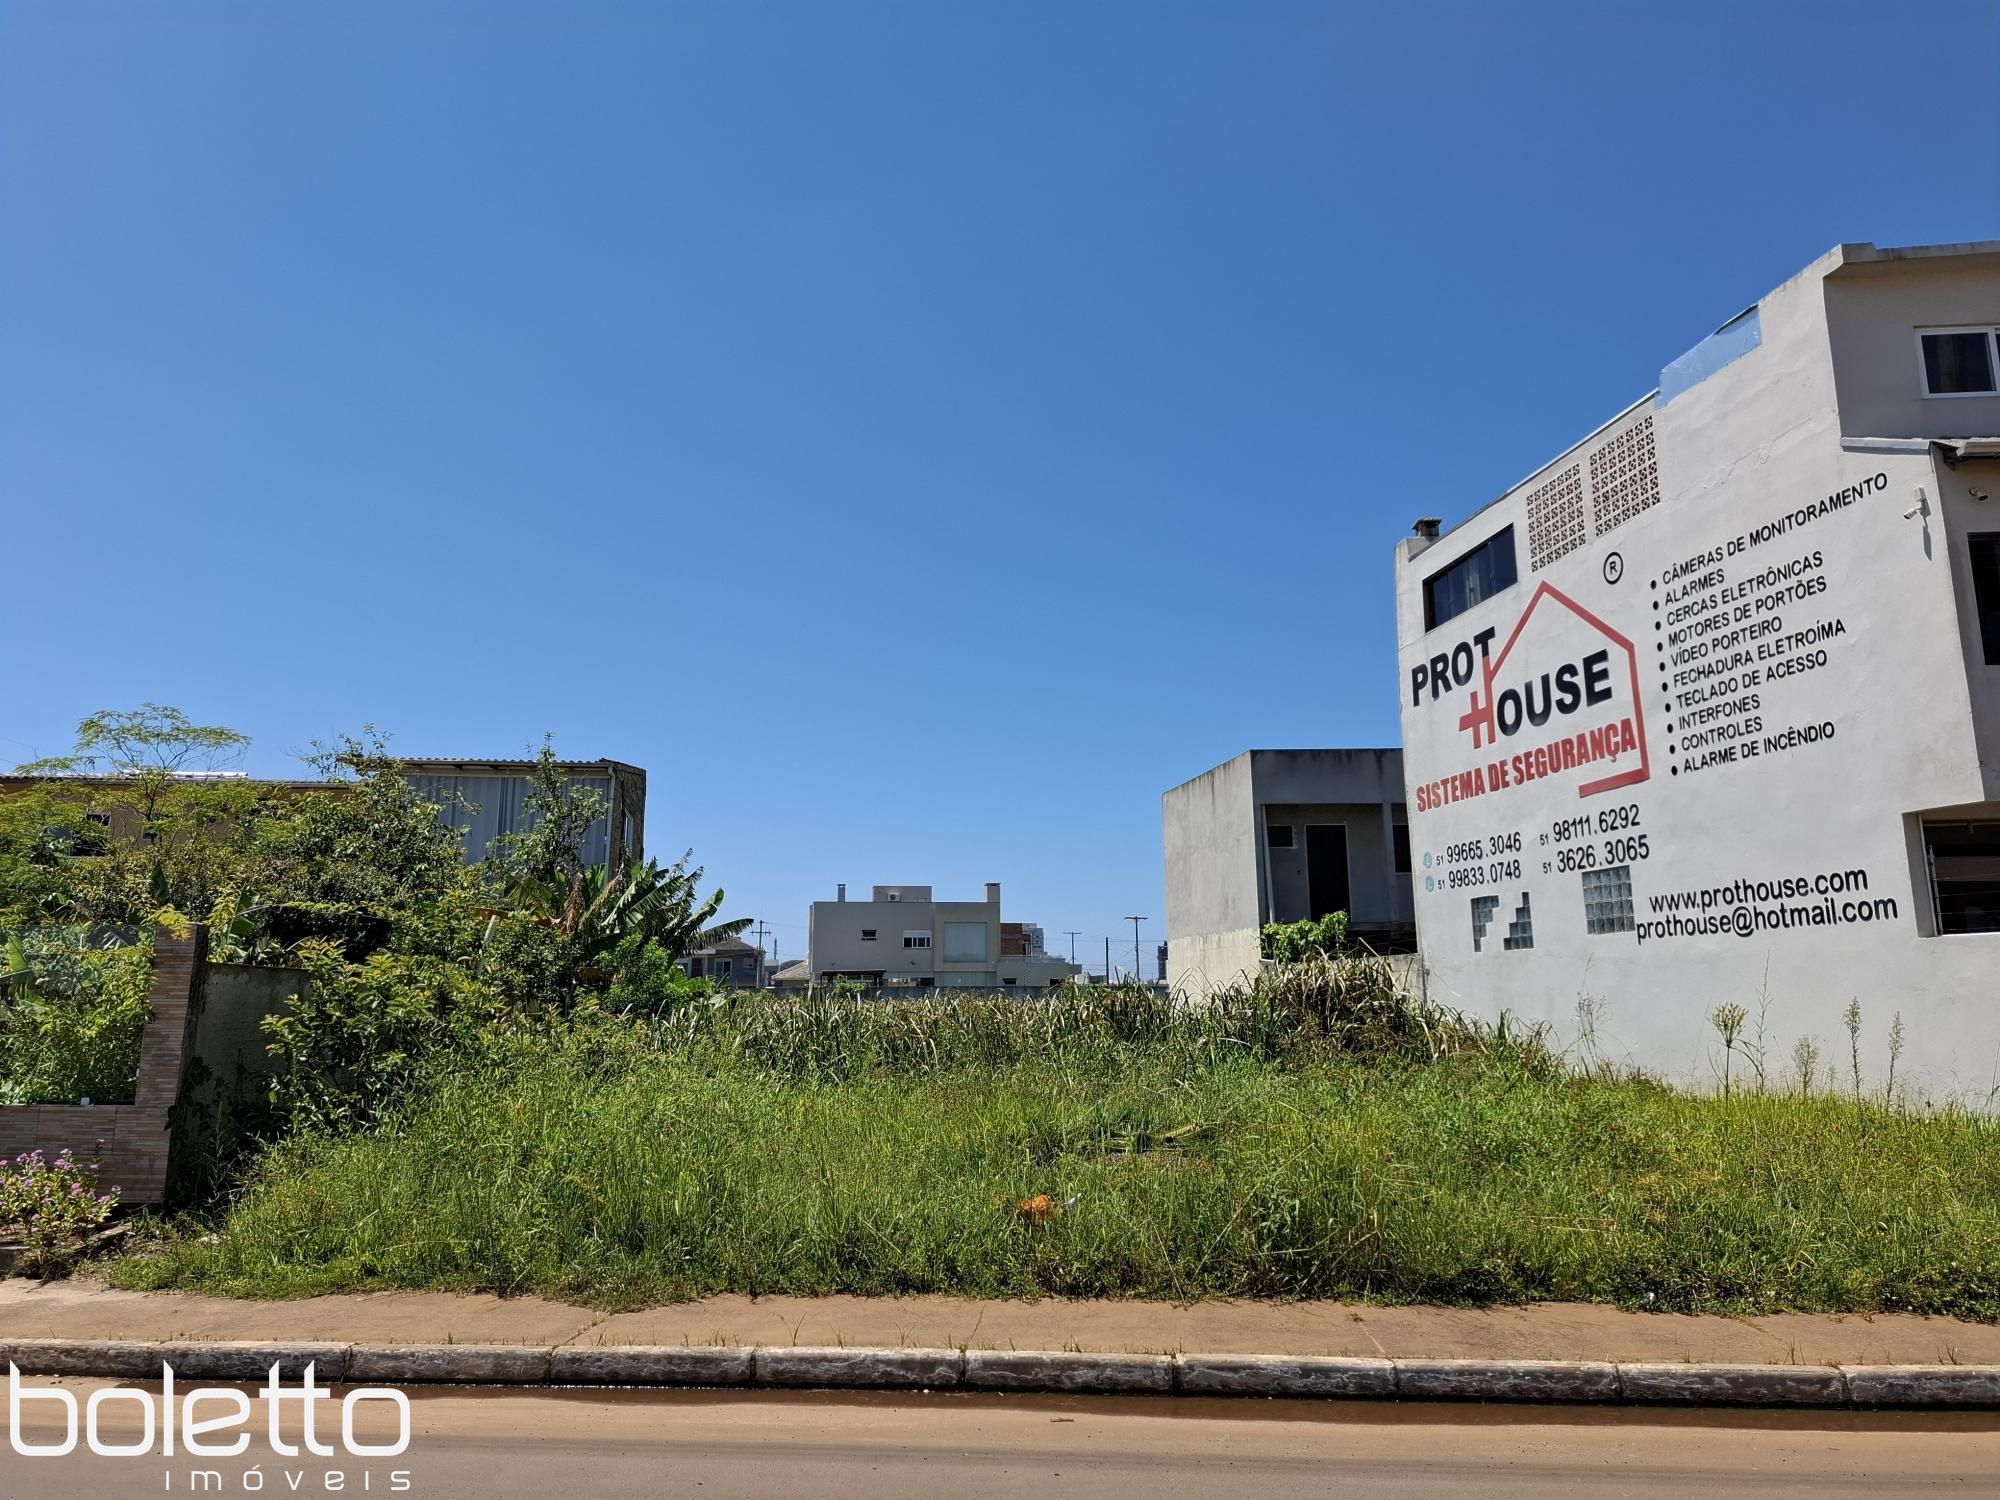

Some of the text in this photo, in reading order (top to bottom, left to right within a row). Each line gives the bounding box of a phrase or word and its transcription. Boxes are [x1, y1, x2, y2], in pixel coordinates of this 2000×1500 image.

[1662, 472, 1888, 585] CÂMERAS DE MONITORAMENTO
[1665, 568, 1725, 606] ALARMES
[1667, 550, 1823, 626] CERCAS ELETRÔNICAS
[1668, 575, 1827, 647] MOTORES DE PORTÕES
[1411, 625, 1496, 707] PROT
[1670, 615, 1783, 667] VÍDEO PORTEIRO
[1673, 618, 1846, 688] FECHADURA ELETROÍMA
[1676, 649, 1827, 709] TECLADO DE ACESSO
[1678, 693, 1760, 730] INTERFONES
[1681, 716, 1763, 751] CONTROLES
[1416, 718, 1638, 812] SISTEMA DE SEGURANÇA
[1683, 721, 1835, 773] ALARME DE INCÊNDIO
[1436, 831, 1522, 866] 51 99665.3046
[1539, 803, 1640, 846] 51 98111.6292
[1437, 859, 1521, 890] 51 99833.0748
[1543, 834, 1650, 874] 51 3626.3065
[1649, 868, 1868, 914] www.prothouse.com
[1636, 897, 1898, 946] prothouse@hotmail.com
